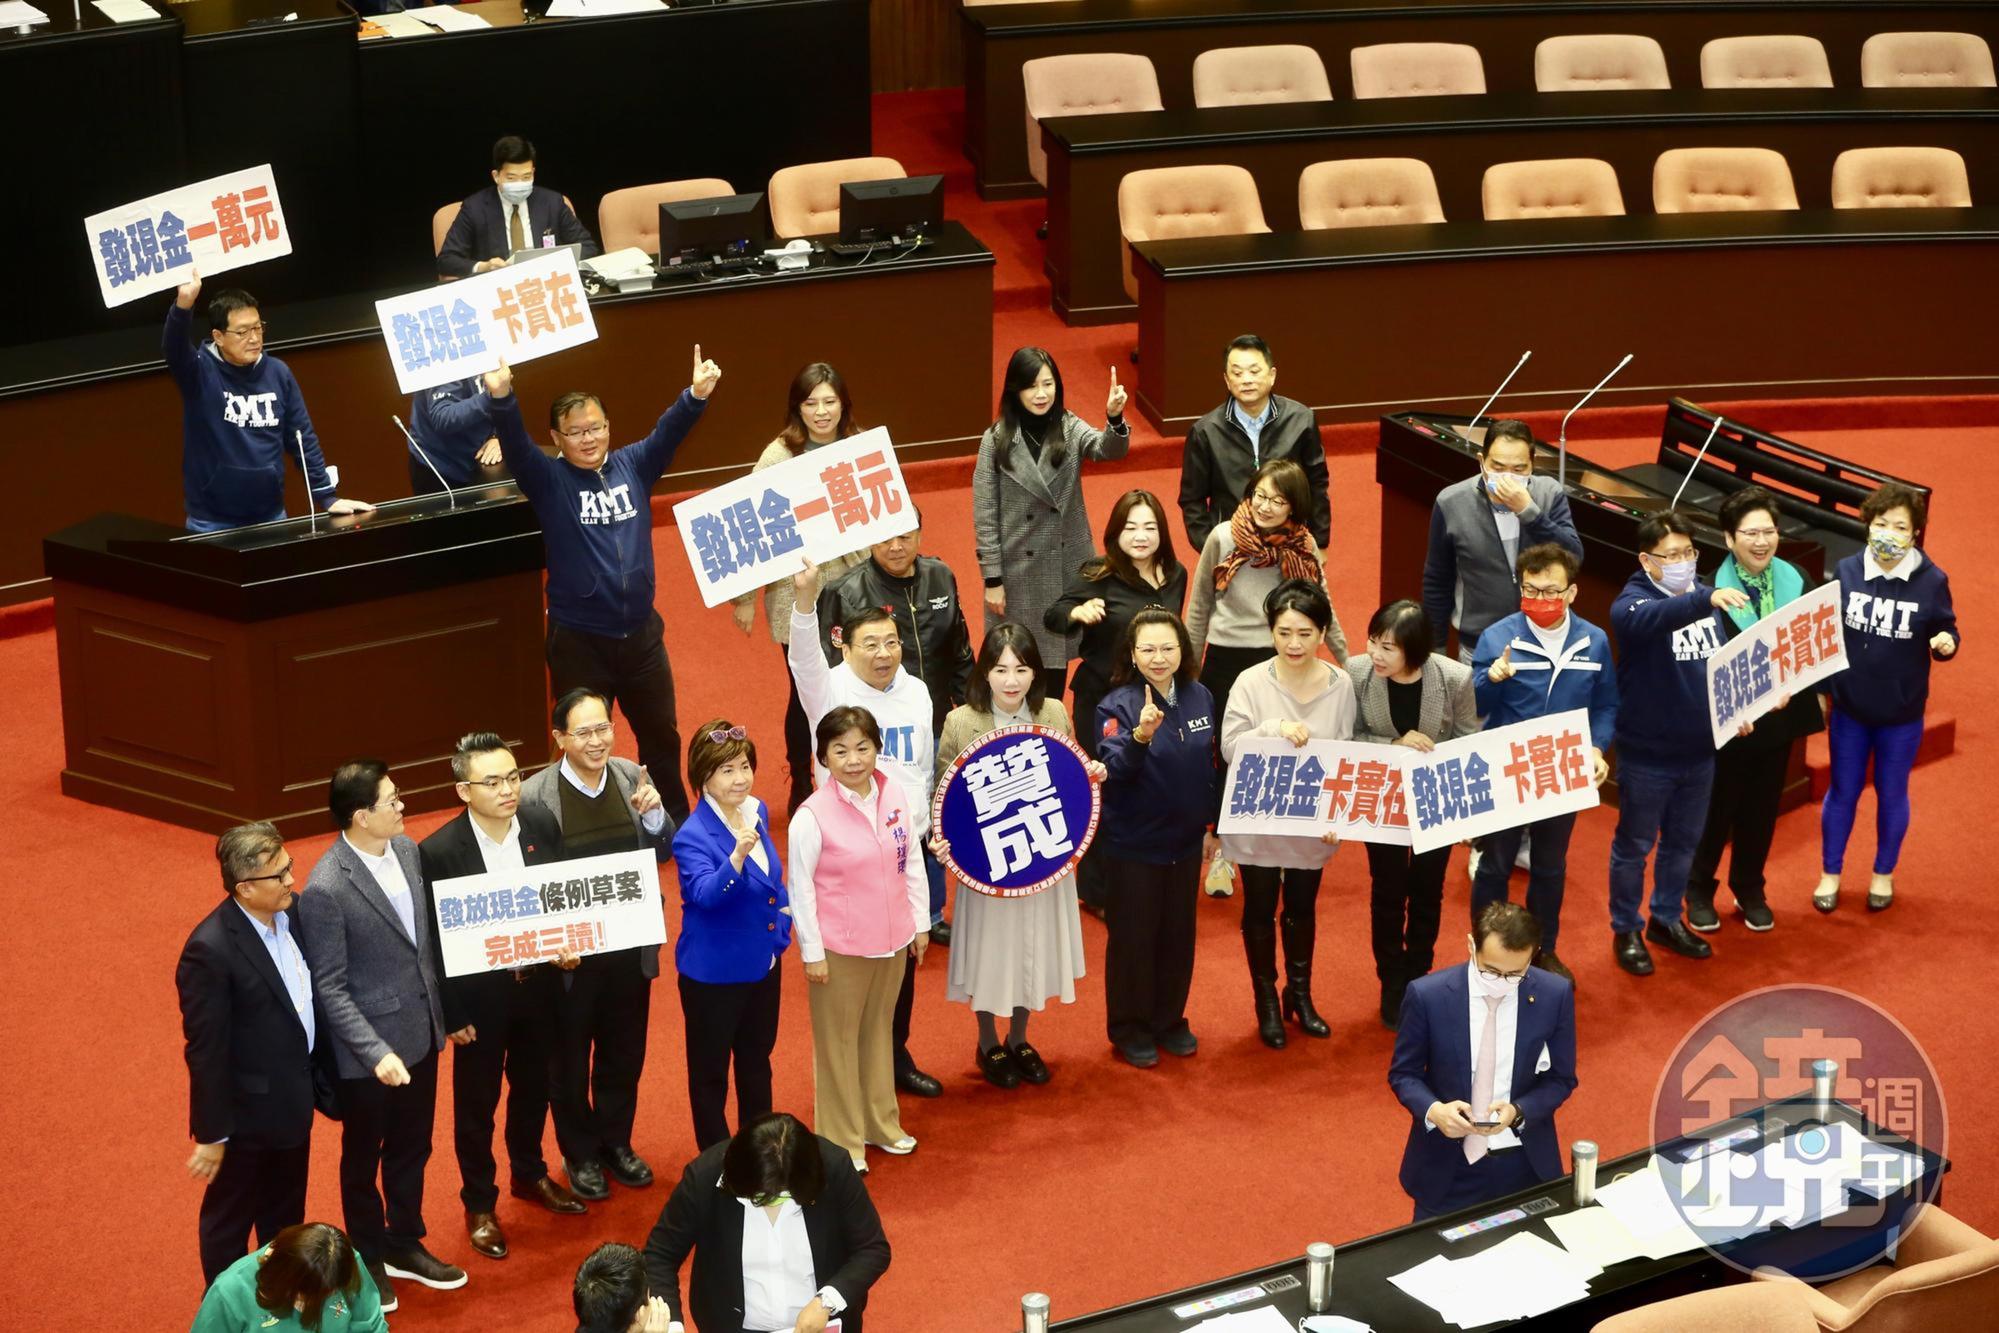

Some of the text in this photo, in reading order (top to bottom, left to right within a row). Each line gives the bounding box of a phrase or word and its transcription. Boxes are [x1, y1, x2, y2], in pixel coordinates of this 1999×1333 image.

[98, 185, 280, 289] 發現金一萬元
[391, 271, 585, 373] 發現金 卡實在
[579, 483, 634, 517] KMT
[690, 450, 903, 584] 發現金一萬元
[1672, 616, 1720, 653] KMT
[1846, 591, 1919, 632] KMT
[1713, 603, 1840, 728] 發現金卡實在
[876, 725, 915, 762] MT
[1187, 715, 1209, 729] KMT
[1412, 729, 1589, 831] 發現金 卡實在
[439, 870, 643, 930] 發放現金條例草案
[484, 921, 605, 967] 完成三讀!
